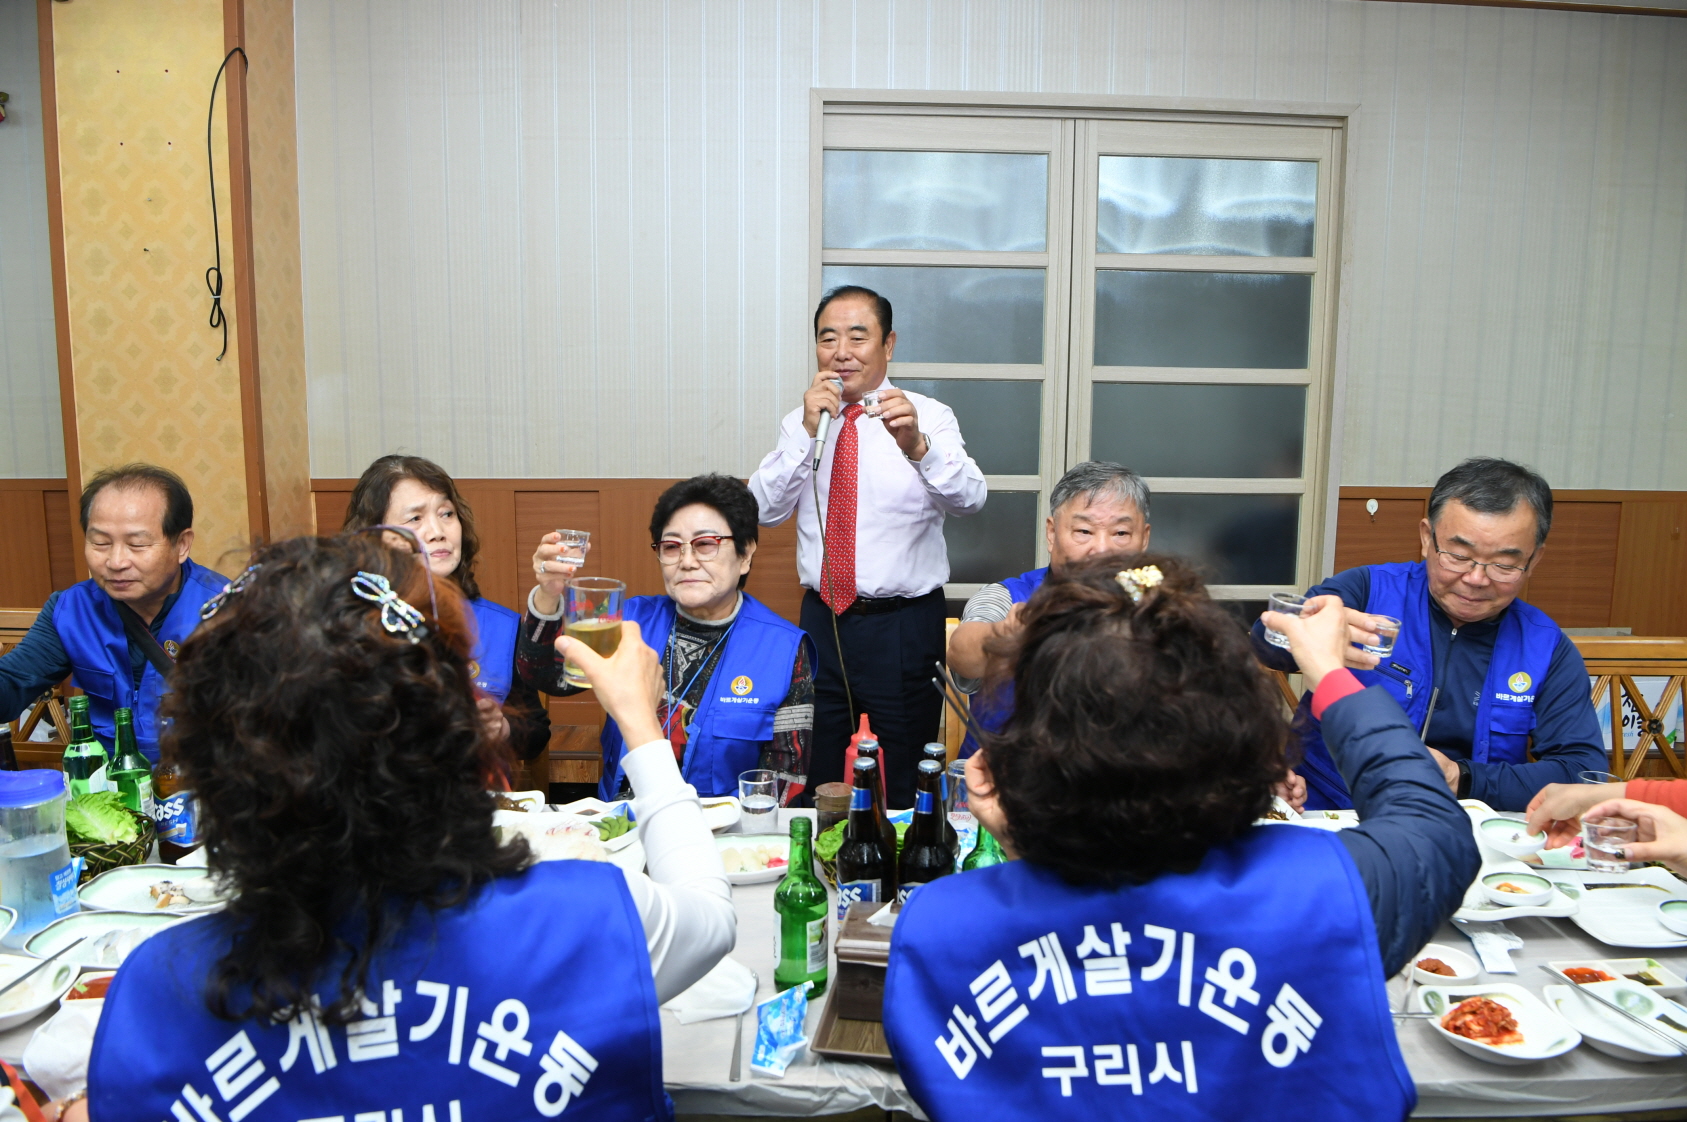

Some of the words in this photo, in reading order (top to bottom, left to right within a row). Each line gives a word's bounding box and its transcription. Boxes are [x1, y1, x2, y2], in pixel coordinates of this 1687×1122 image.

[1495, 692, 1536, 703] 바르게살기운
[155, 797, 184, 821] ass
[935, 922, 1322, 1080] 바르게살기운동
[1041, 1040, 1198, 1097] 구리시
